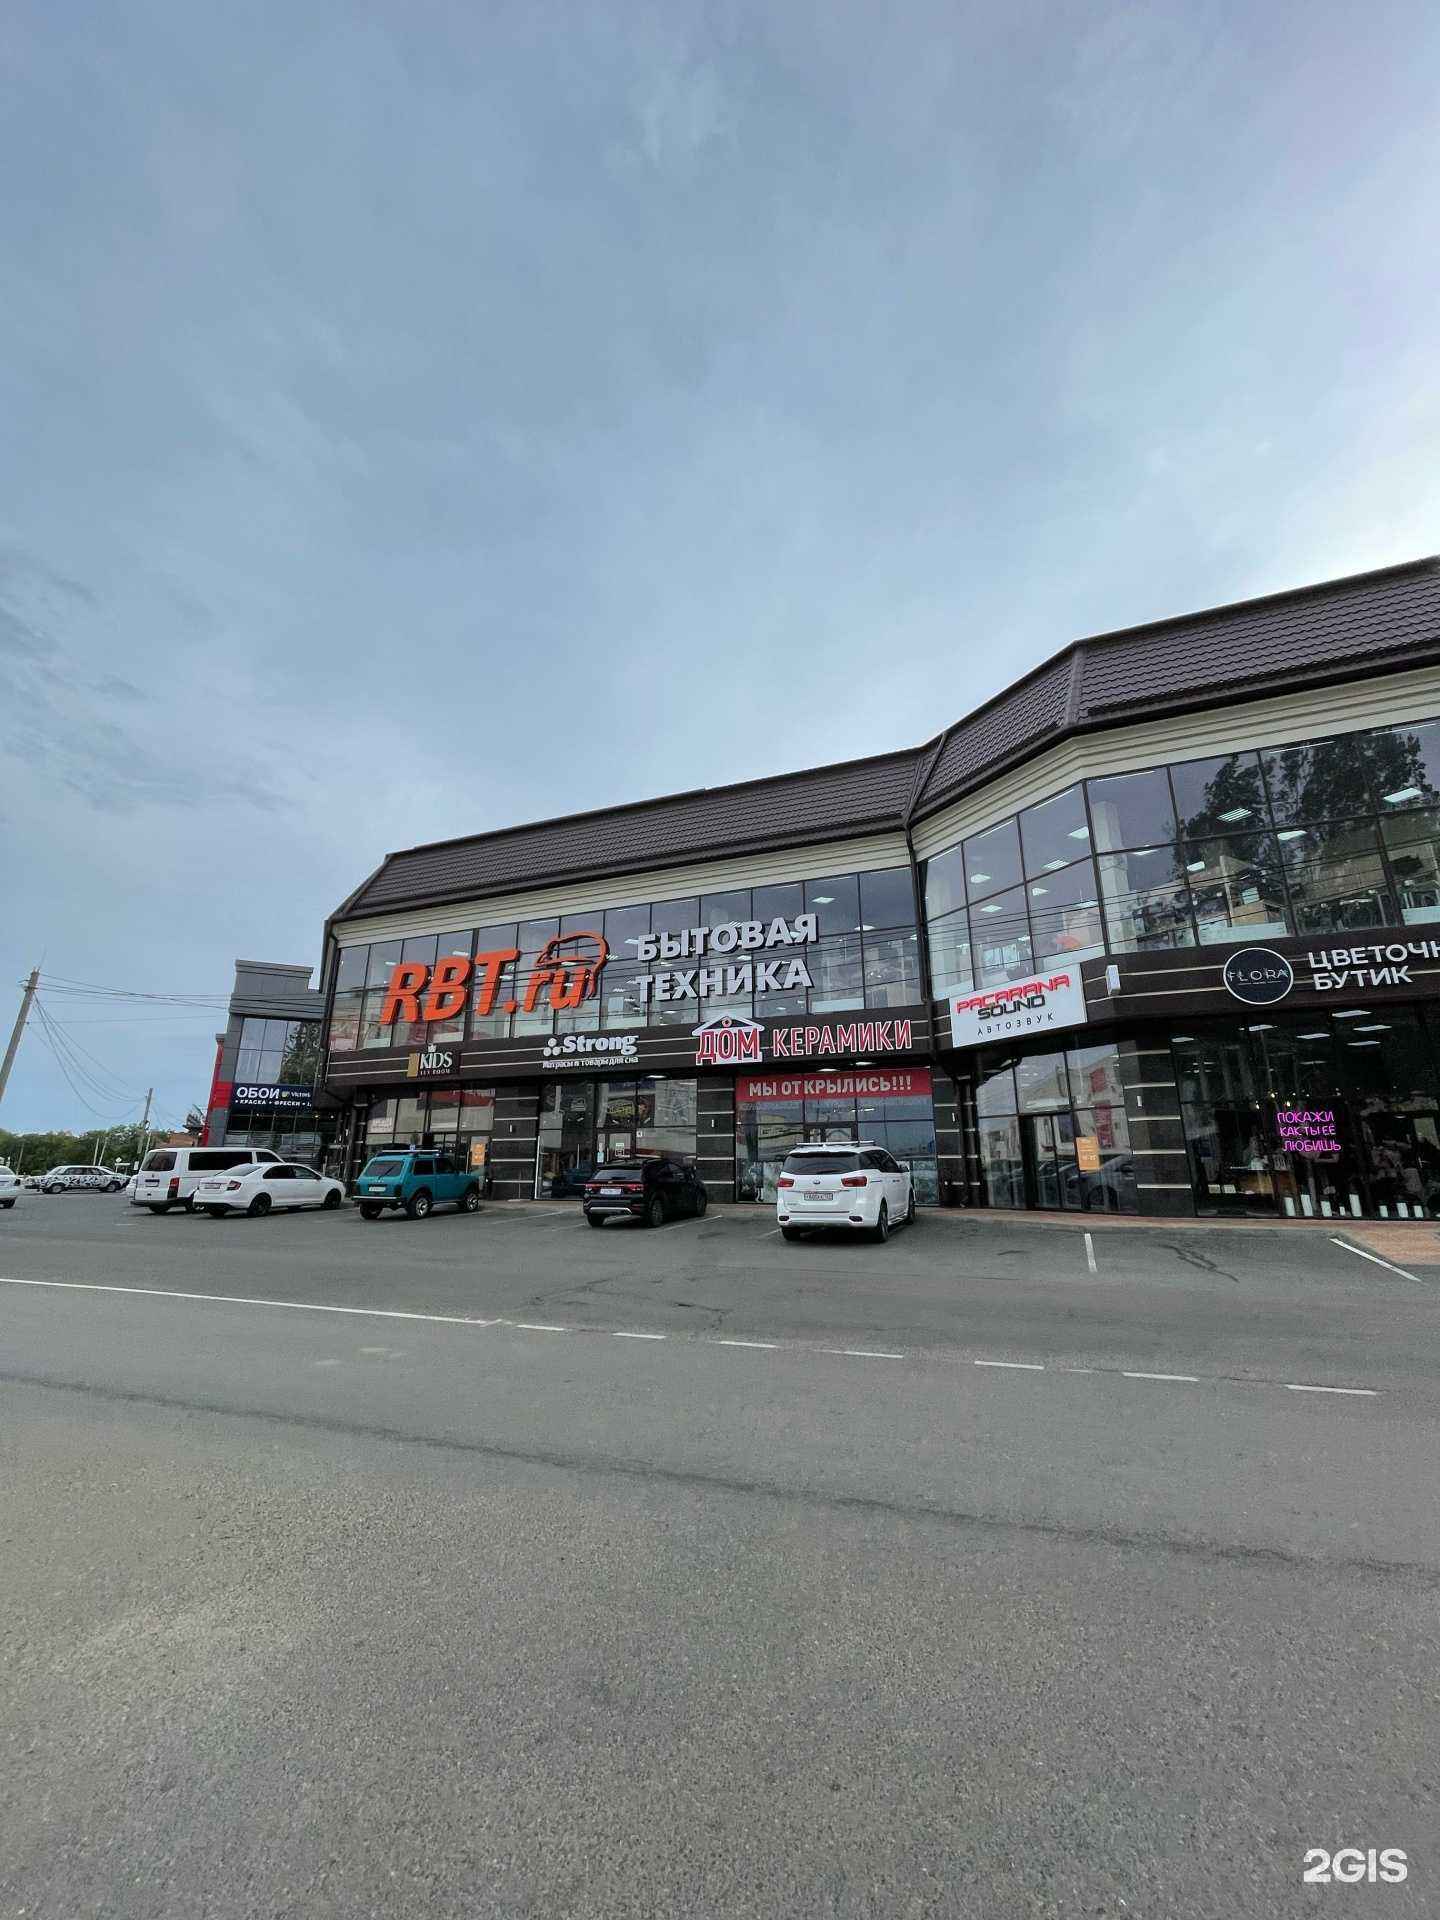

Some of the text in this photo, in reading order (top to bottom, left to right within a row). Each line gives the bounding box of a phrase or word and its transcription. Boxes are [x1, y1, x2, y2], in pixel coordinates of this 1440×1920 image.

[637, 913, 817, 961] БЫТОВАЯ
[635, 958, 815, 1003] ТЕХНИКА
[1227, 967, 1289, 982] FLORA
[1313, 966, 1413, 991] БУТИК
[379, 949, 588, 1025] RBT.ru
[956, 974, 1070, 1014] PACARANA
[977, 994, 1046, 1020] SOUND
[977, 1012, 1054, 1036] АВТОЗВУК
[562, 1035, 639, 1056] Strong
[695, 1019, 912, 1065] ДОМ КЕРАМИКИ
[420, 1051, 453, 1070] KIDS
[236, 1086, 280, 1099] ОБОИ
[749, 1080, 777, 1097] МЫ
[1277, 1111, 1334, 1123] ПОКАЖИ
[1280, 1126, 1302, 1137] КАК
[1304, 1126, 1320, 1136] ТЫ
[1282, 1139, 1341, 1152] ЛЮБИШЬ
